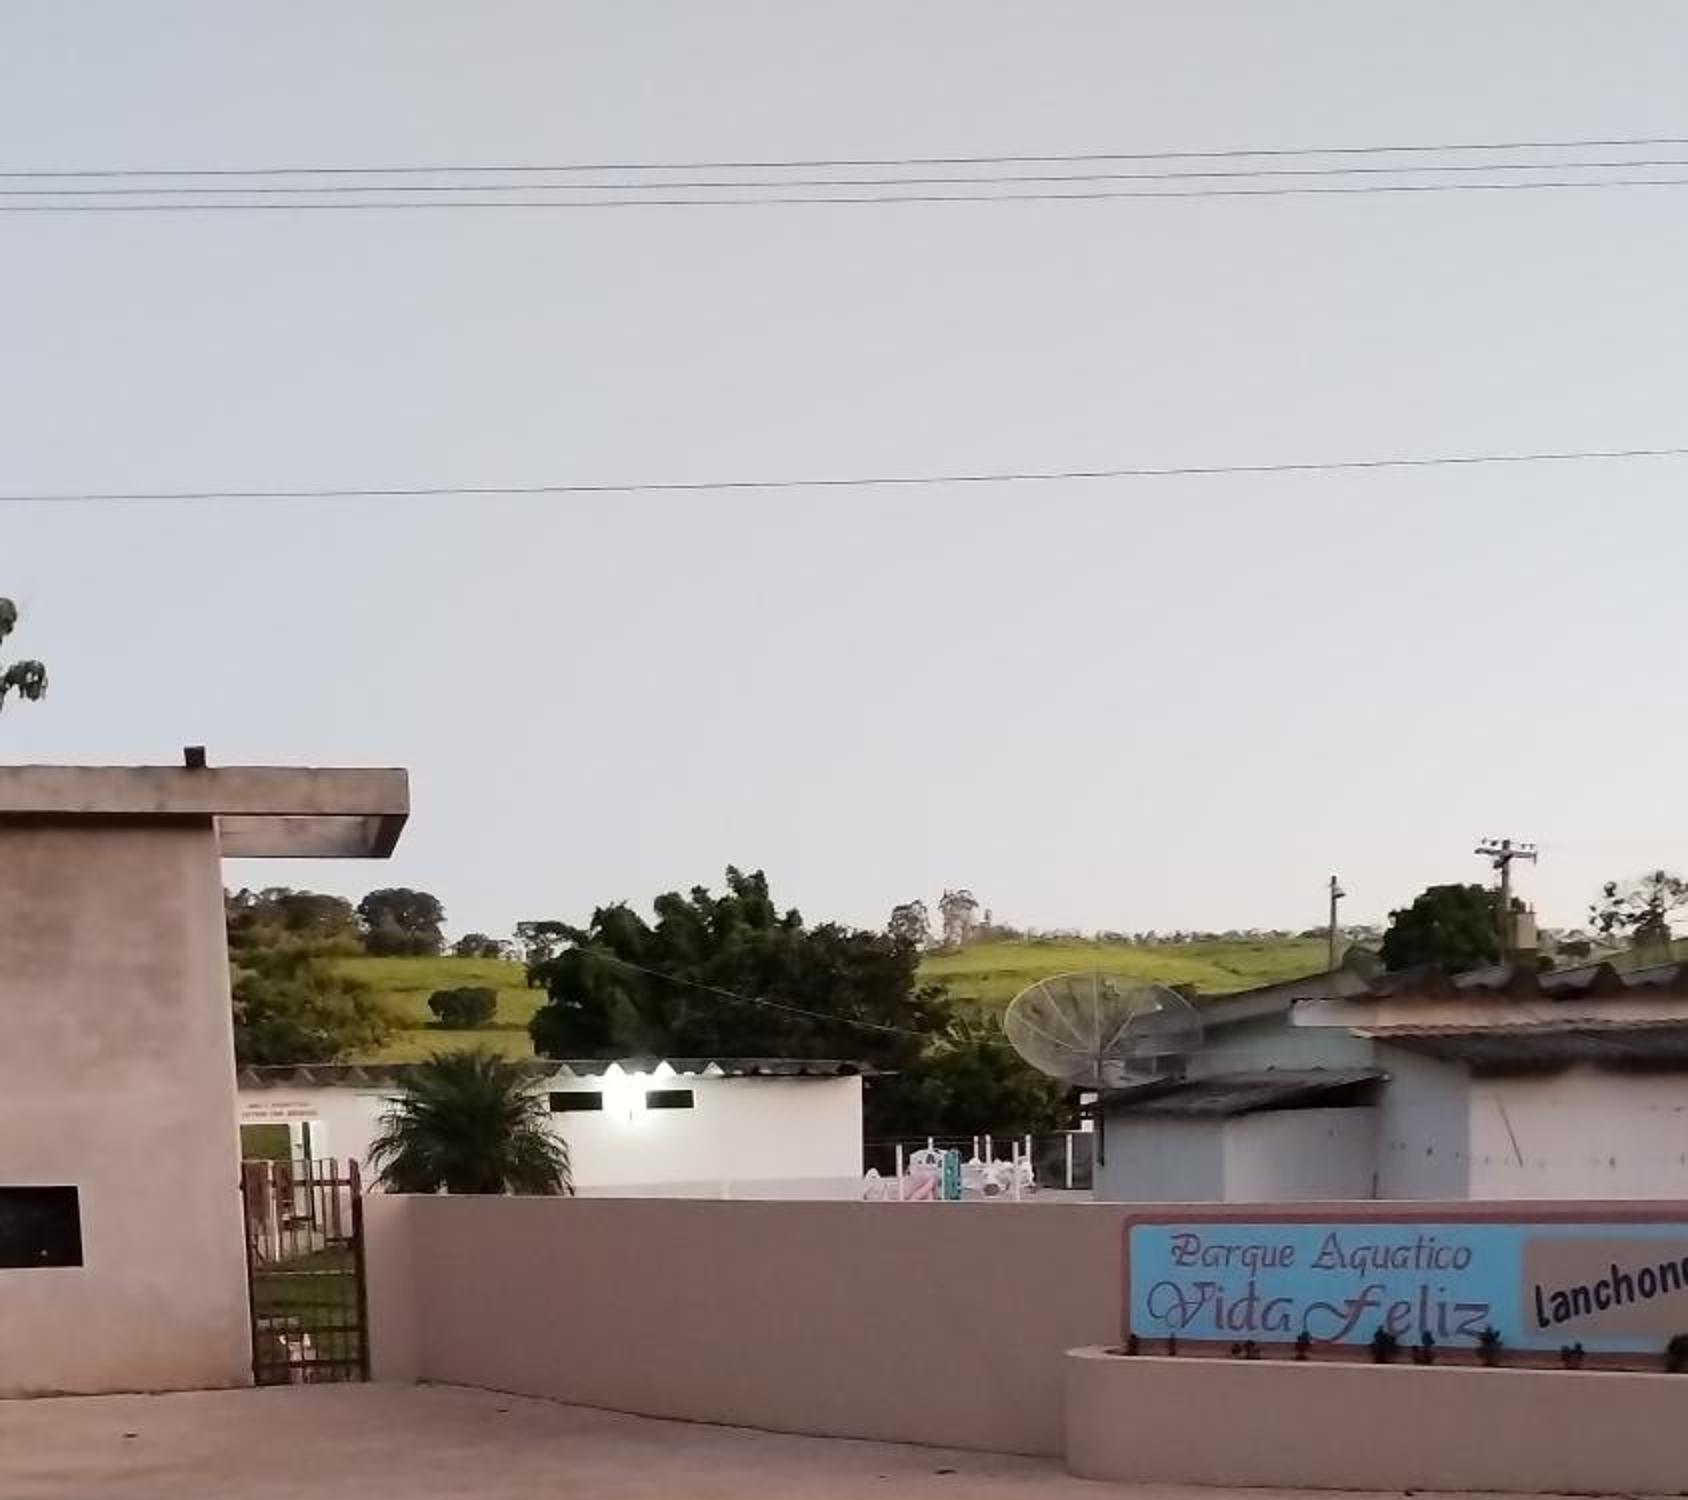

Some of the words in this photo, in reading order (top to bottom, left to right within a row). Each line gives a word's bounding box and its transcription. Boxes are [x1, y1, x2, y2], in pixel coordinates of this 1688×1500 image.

[1170, 1232, 1296, 1279] Parque
[1310, 1230, 1473, 1278] Aquatico
[1146, 1279, 1295, 1333] Vida
